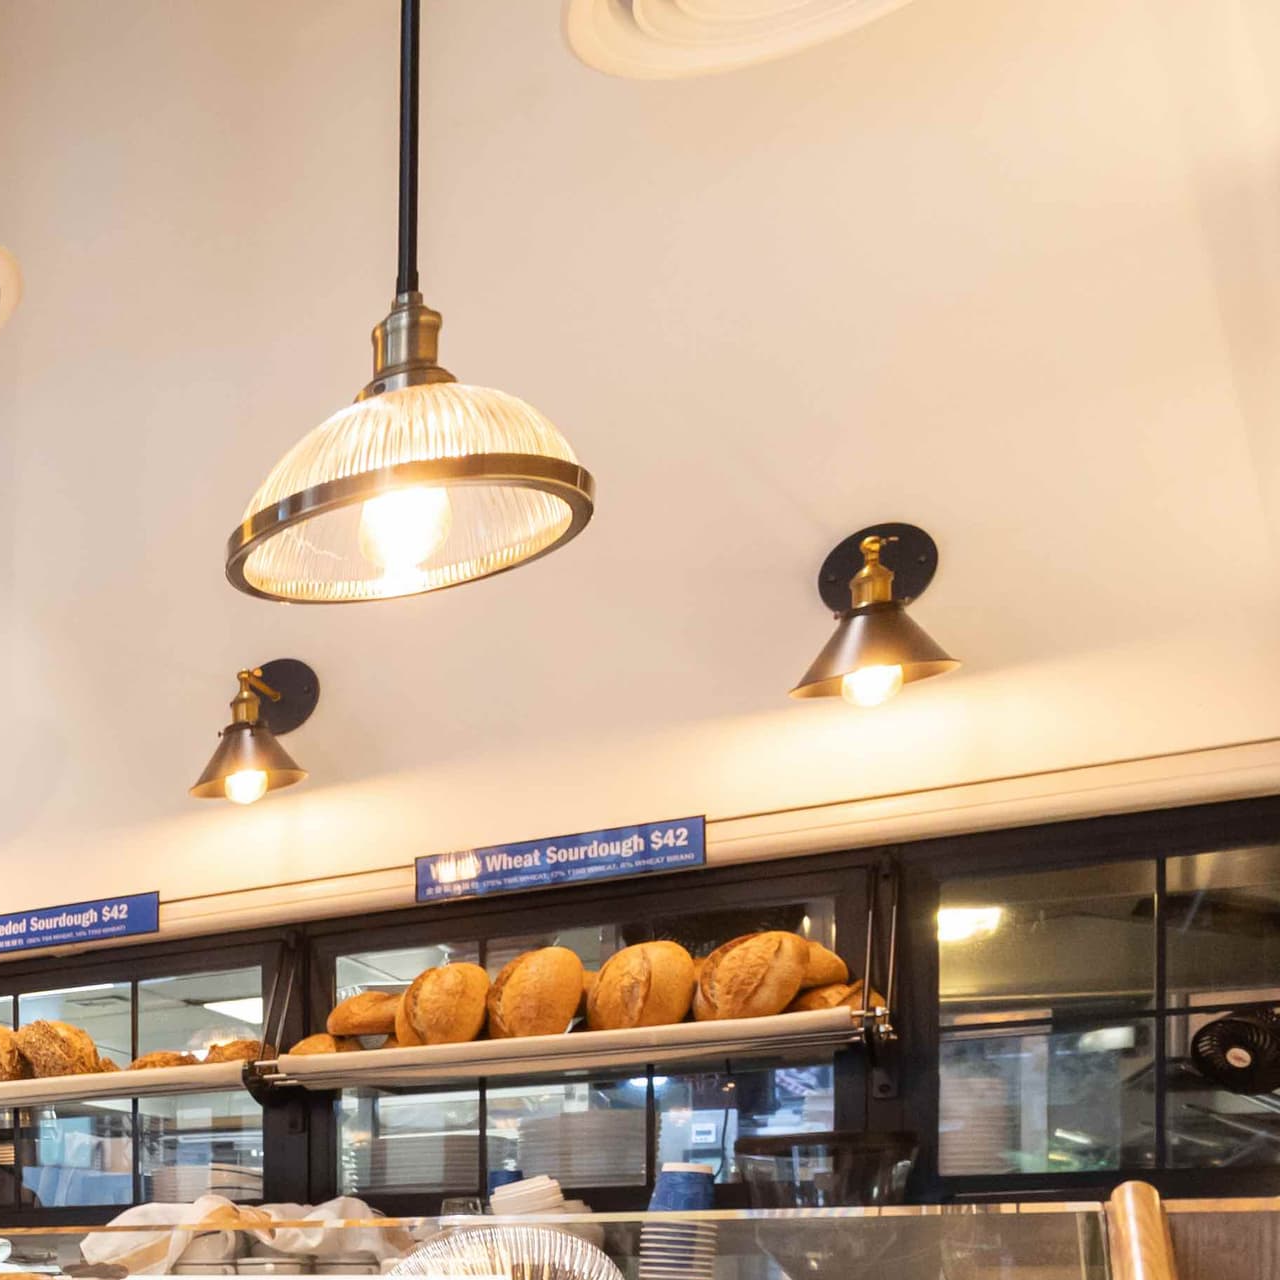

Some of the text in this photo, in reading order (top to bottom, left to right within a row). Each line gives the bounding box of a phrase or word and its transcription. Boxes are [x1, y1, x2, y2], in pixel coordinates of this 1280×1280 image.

[486, 851, 541, 873] Wheat
[547, 835, 644, 865] Sourdough
[651, 827, 688, 850] $42
[30, 908, 98, 931] Sourdough
[102, 903, 128, 922] $42
